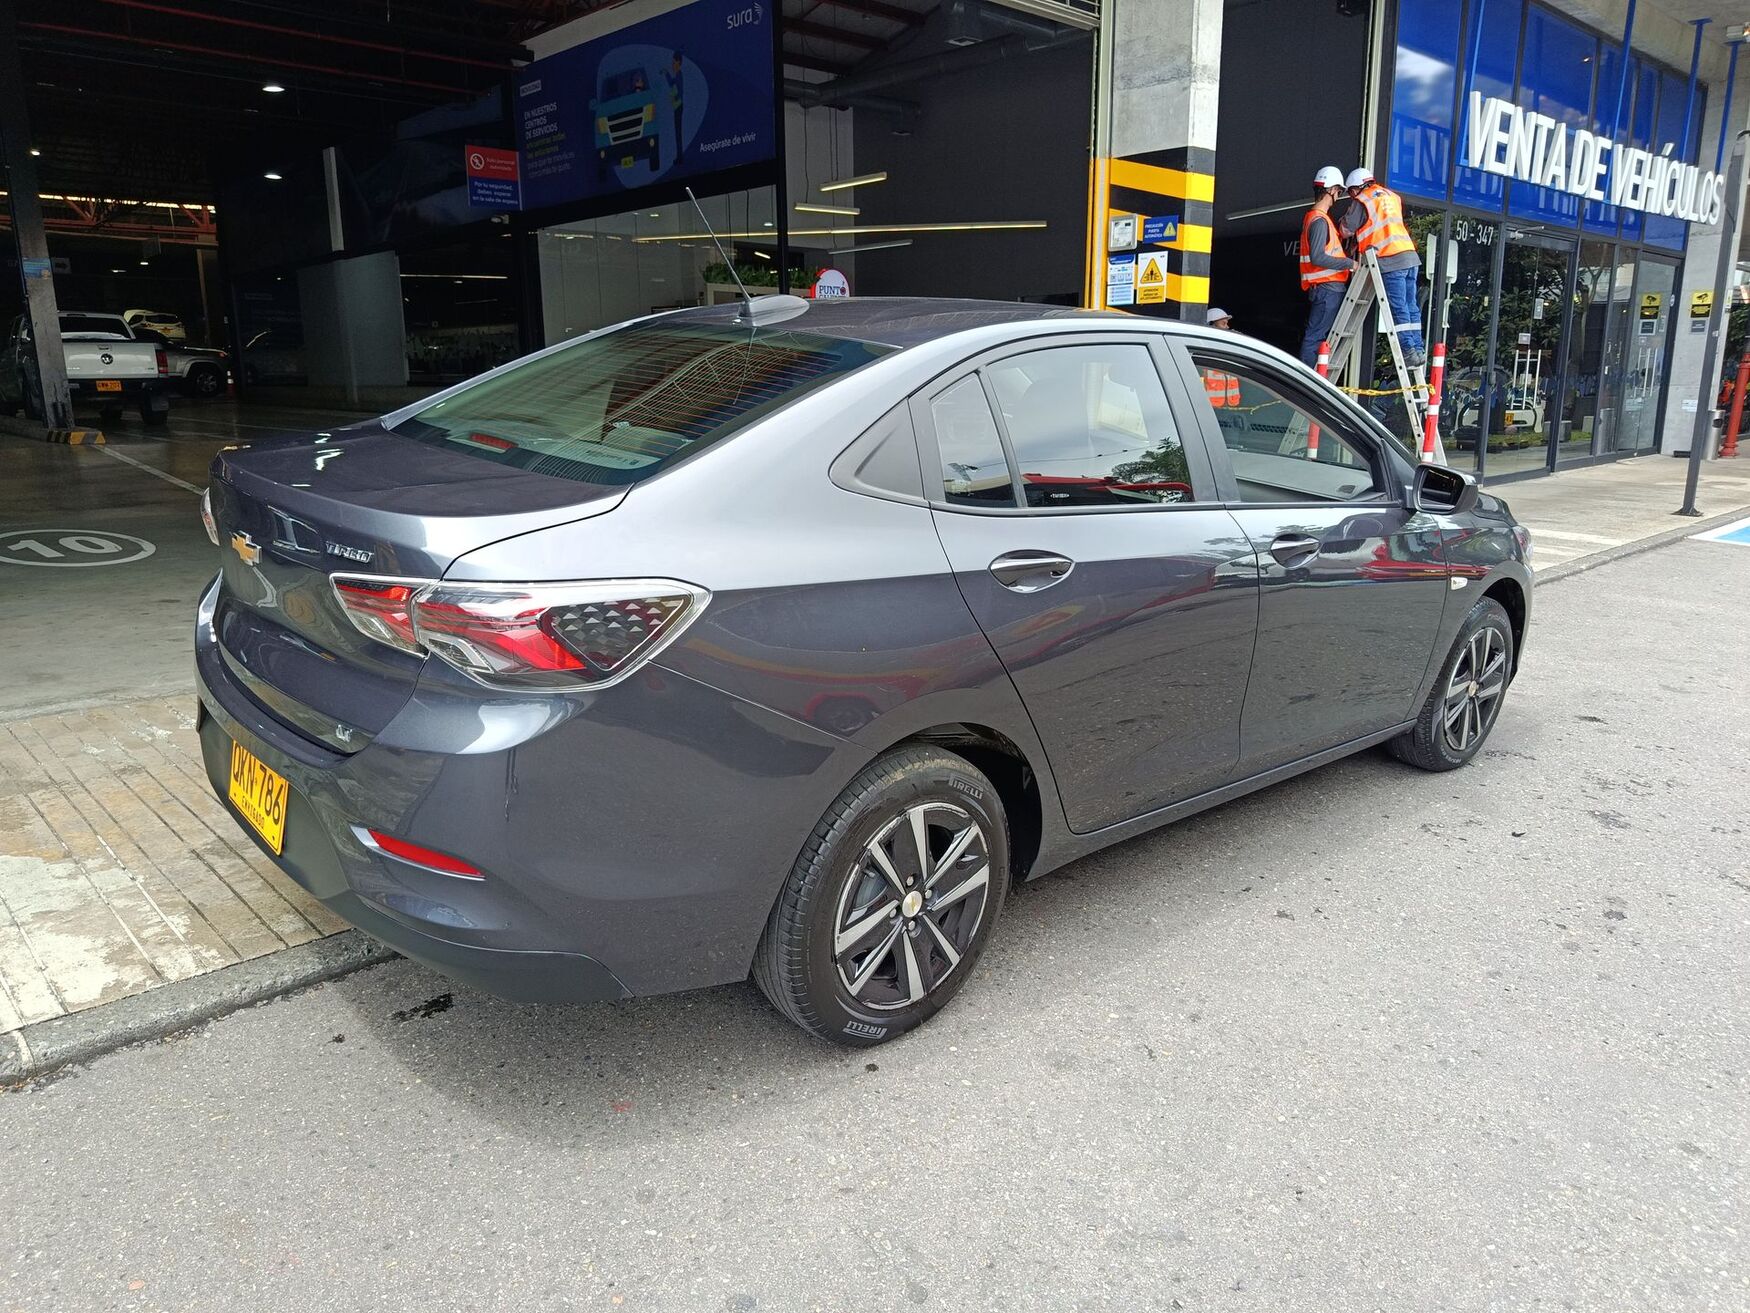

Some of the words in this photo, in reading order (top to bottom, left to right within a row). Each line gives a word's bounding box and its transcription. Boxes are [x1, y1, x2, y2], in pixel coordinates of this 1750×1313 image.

[727, 8, 753, 30] sura
[732, 134, 742, 146] de
[742, 131, 757, 144] vivir
[1468, 91, 1567, 191] VENTA
[1568, 129, 1613, 200] DE
[1611, 142, 1725, 225] VEHÍCULOS
[1455, 220, 1468, 242] 50
[1476, 224, 1494, 246] 347
[7, 535, 123, 558] 10
[948, 773, 984, 800] PIRELLI
[241, 795, 265, 829] ENVIGADO
[842, 1020, 888, 1040] PIRELLI
